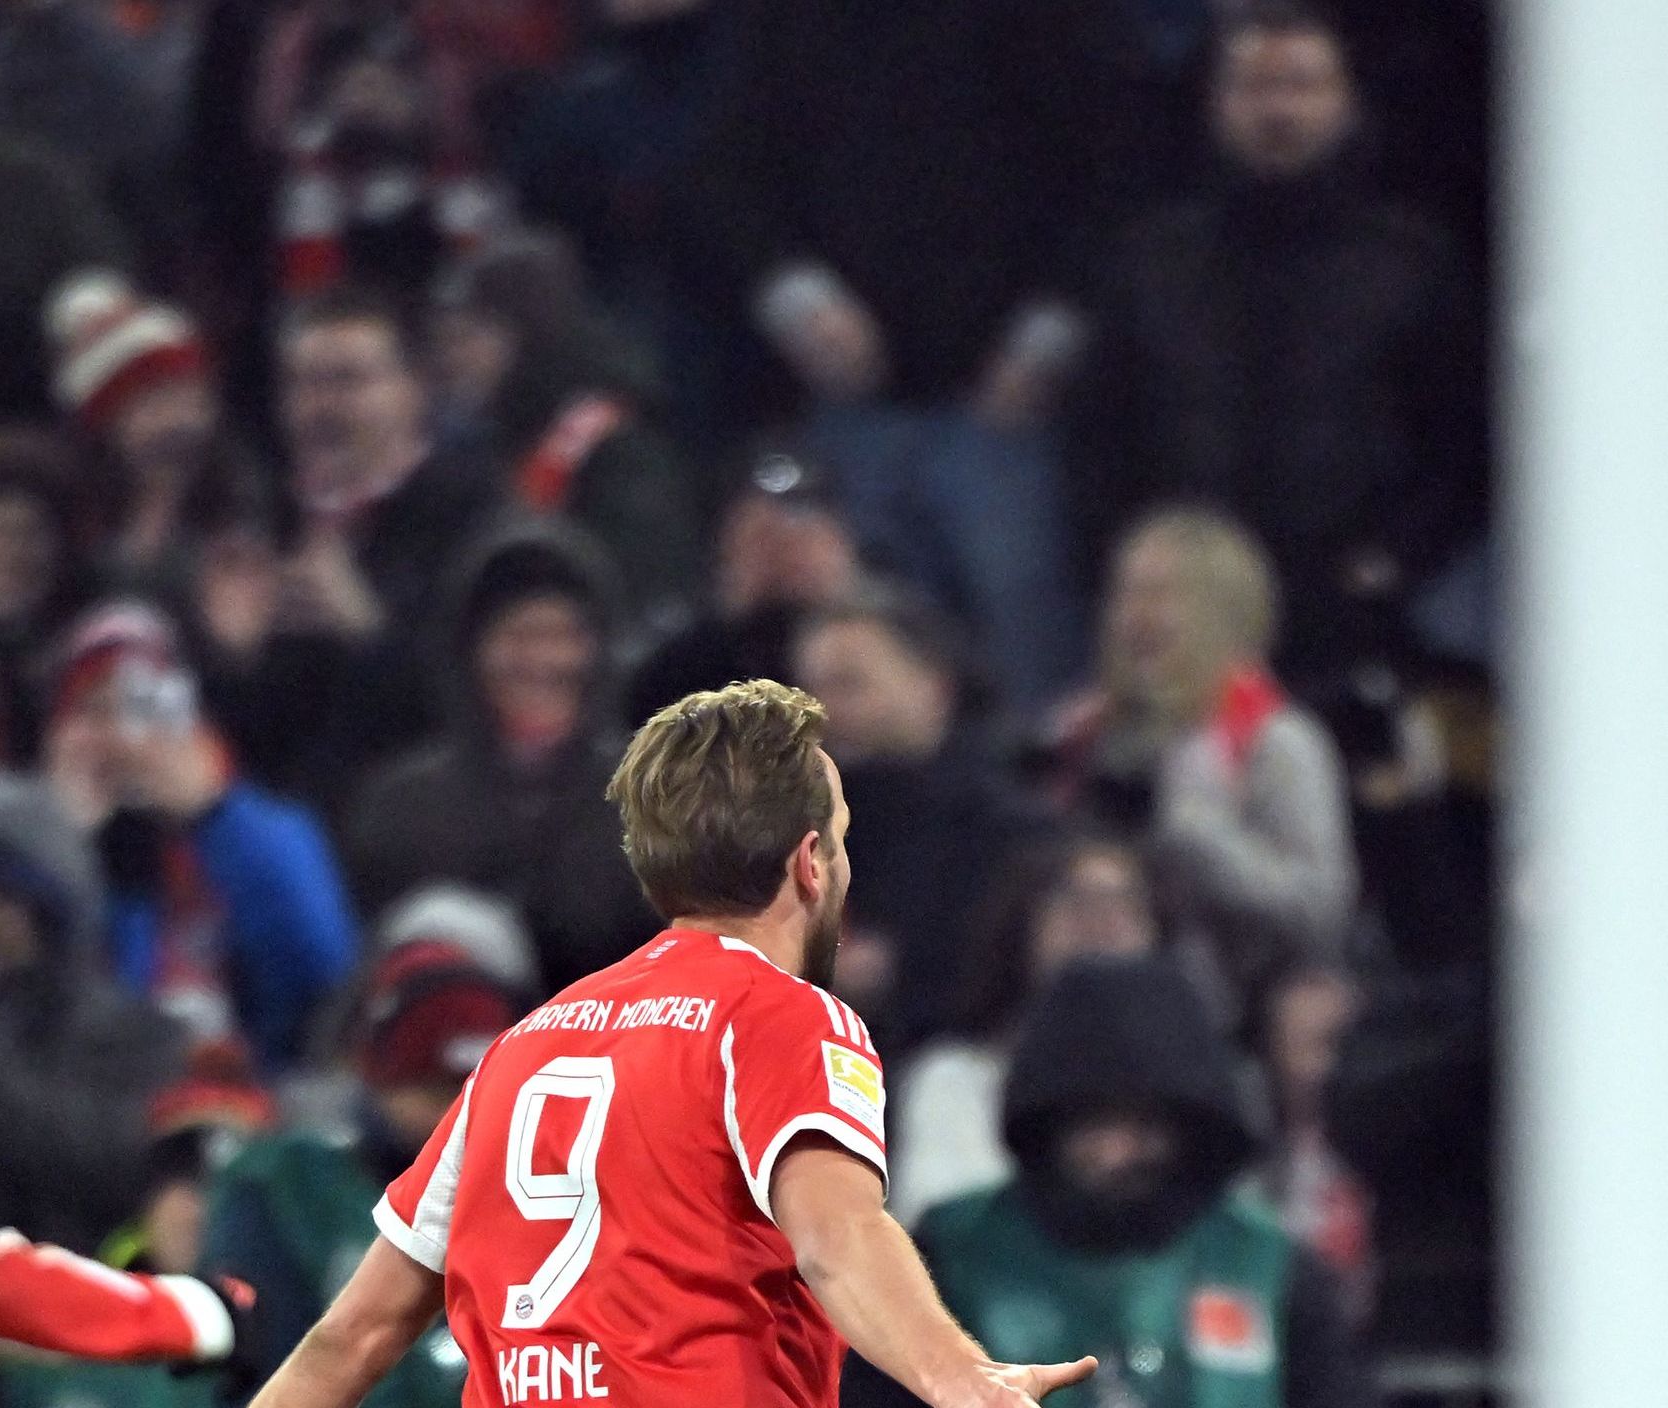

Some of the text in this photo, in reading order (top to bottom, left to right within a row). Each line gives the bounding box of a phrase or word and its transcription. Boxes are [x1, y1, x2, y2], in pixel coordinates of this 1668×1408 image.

[524, 998, 614, 1033] BAYERN
[500, 1056, 616, 1329] 9
[498, 1341, 609, 1406] KANE
